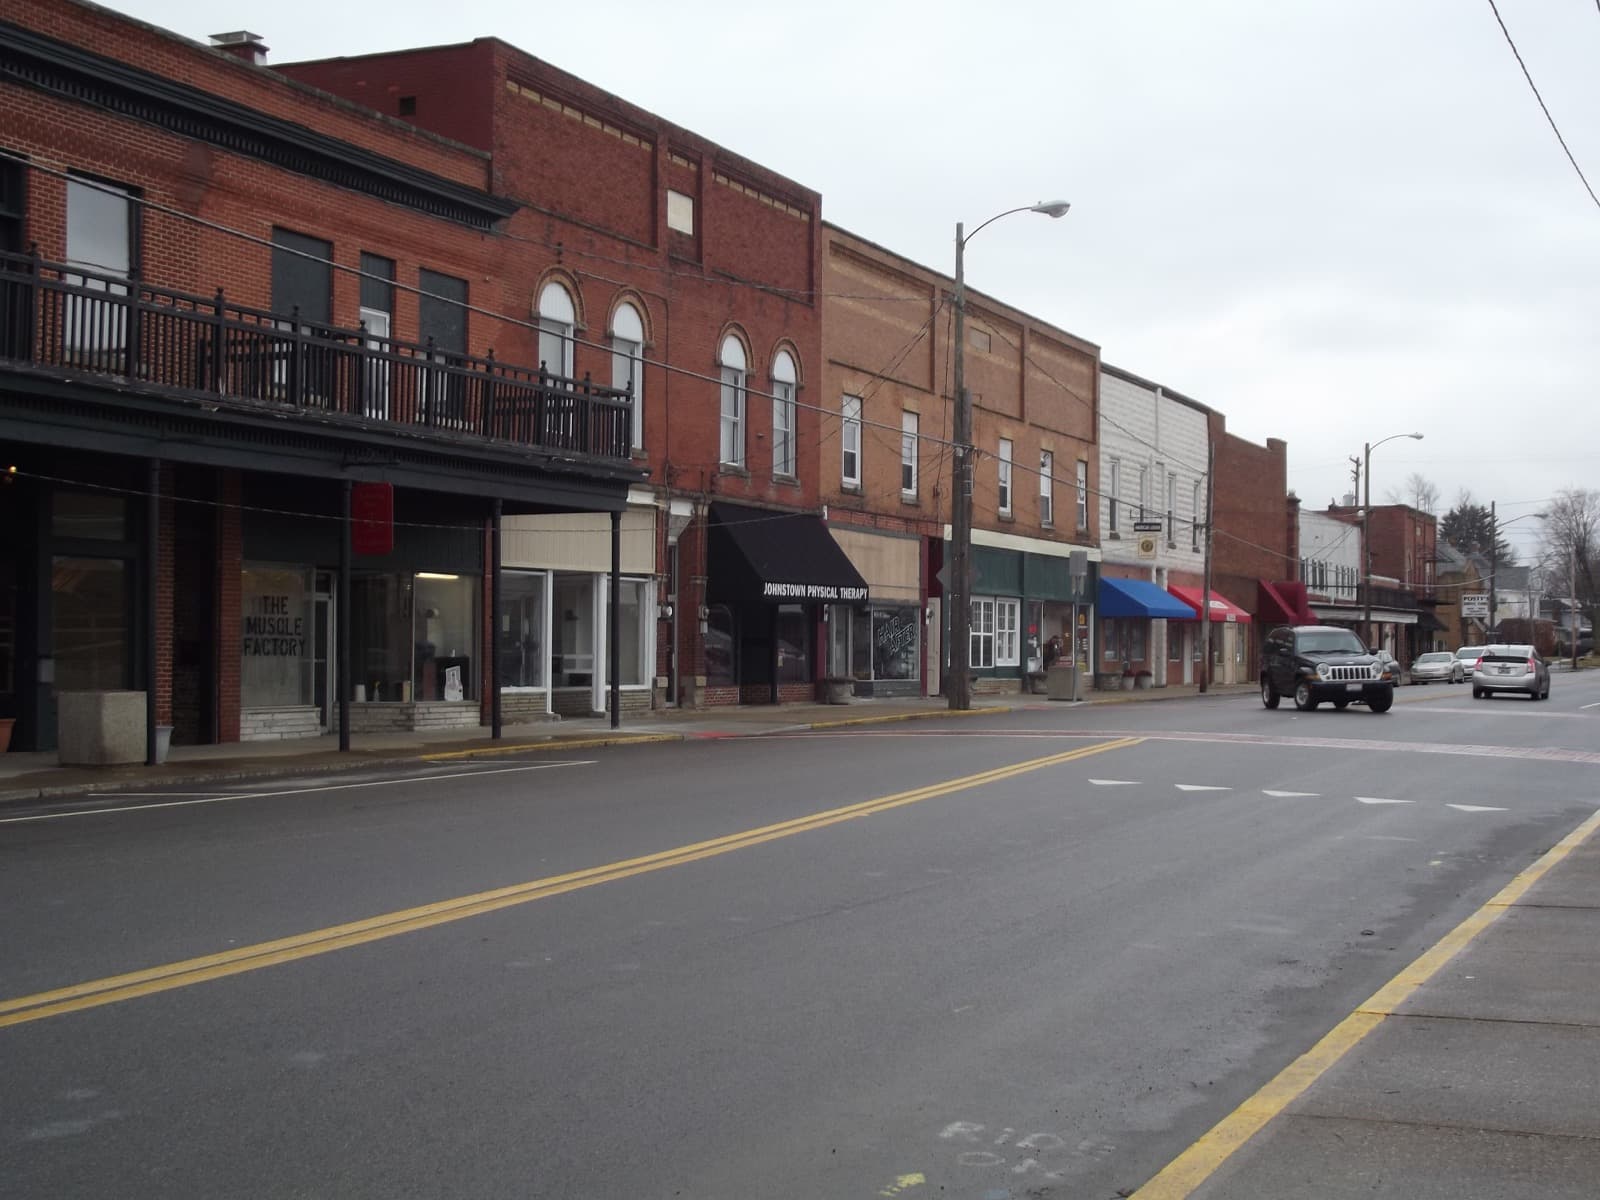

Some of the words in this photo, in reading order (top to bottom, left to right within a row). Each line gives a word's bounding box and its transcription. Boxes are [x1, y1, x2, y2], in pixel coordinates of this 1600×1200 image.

[763, 582, 806, 597] JOHNSTOWN
[808, 585, 838, 599] PHYSICAL
[840, 587, 868, 600] THERAPY
[262, 596, 288, 615] THE
[246, 617, 303, 636] MUSCLE
[244, 638, 306, 657] FACTORY
